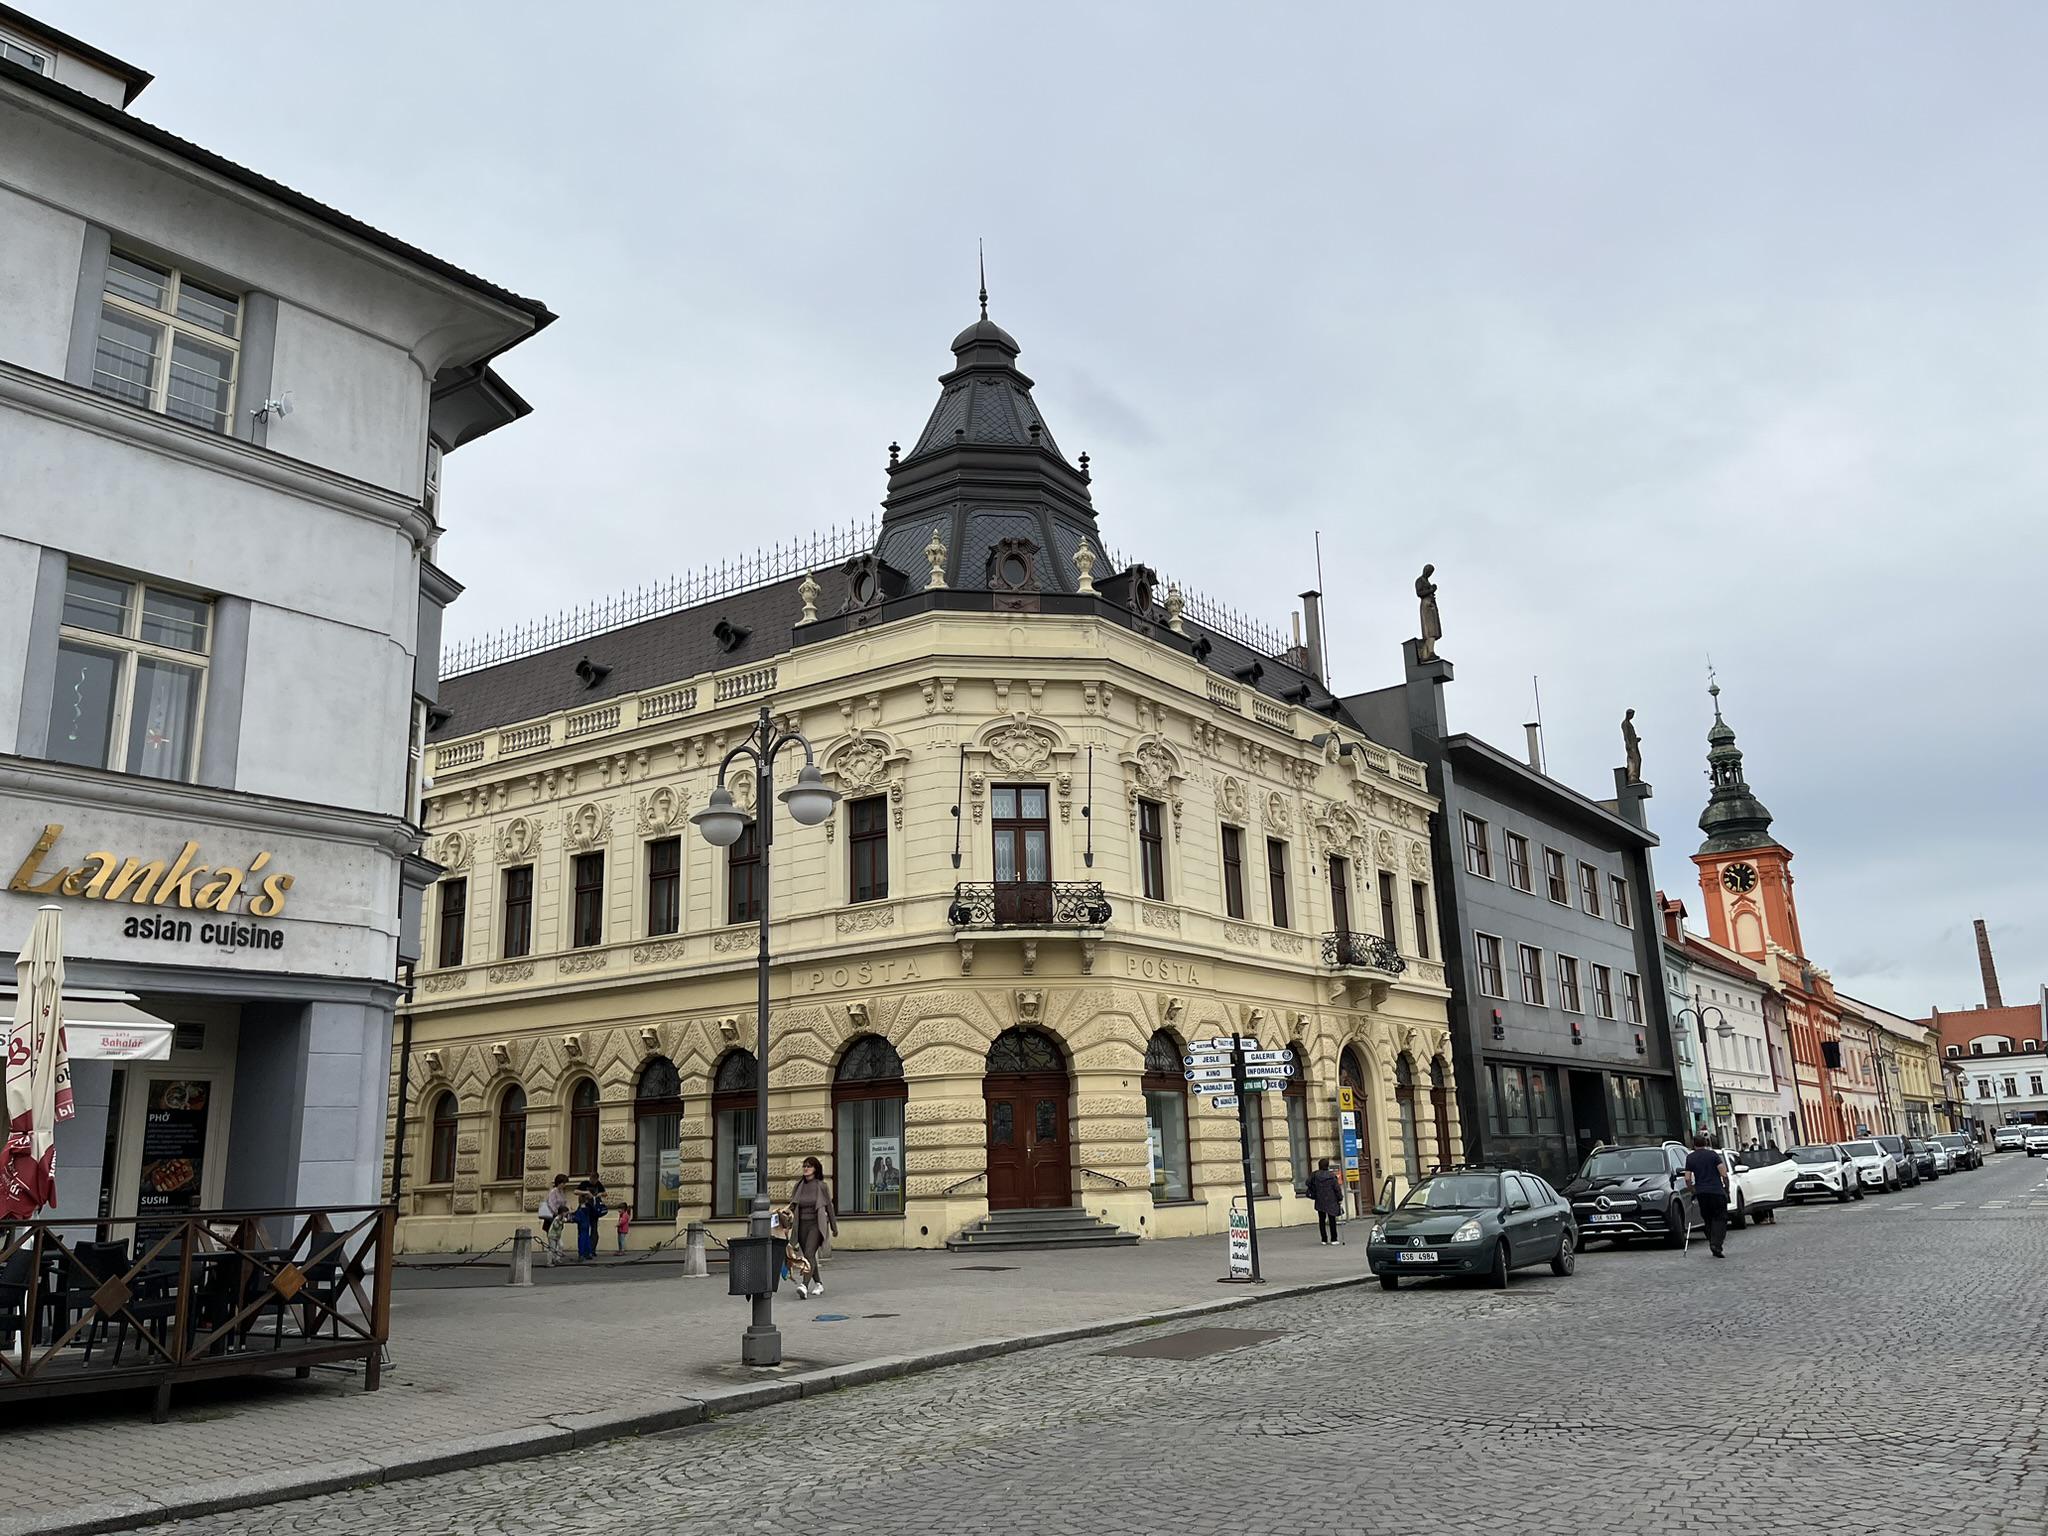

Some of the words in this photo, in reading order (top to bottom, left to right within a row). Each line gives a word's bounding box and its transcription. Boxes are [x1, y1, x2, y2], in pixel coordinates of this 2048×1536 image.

[8, 823, 294, 917] Lanka's
[123, 914, 192, 942] asian
[200, 920, 285, 950] cuisine
[809, 957, 922, 990] POŠTA
[1126, 954, 1200, 985] POŠTA
[1251, 1052, 1276, 1061] GALERIE
[1206, 1069, 1220, 1077] KINO
[1247, 1066, 1282, 1075] INFORMACE
[1268, 1081, 1277, 1089] ICE
[141, 1195, 169, 1205] SUSHI
[1231, 1229, 1249, 1239] OVOCE
[1401, 1252, 1415, 1261] 6S6
[1418, 1252, 1435, 1261] 4984
